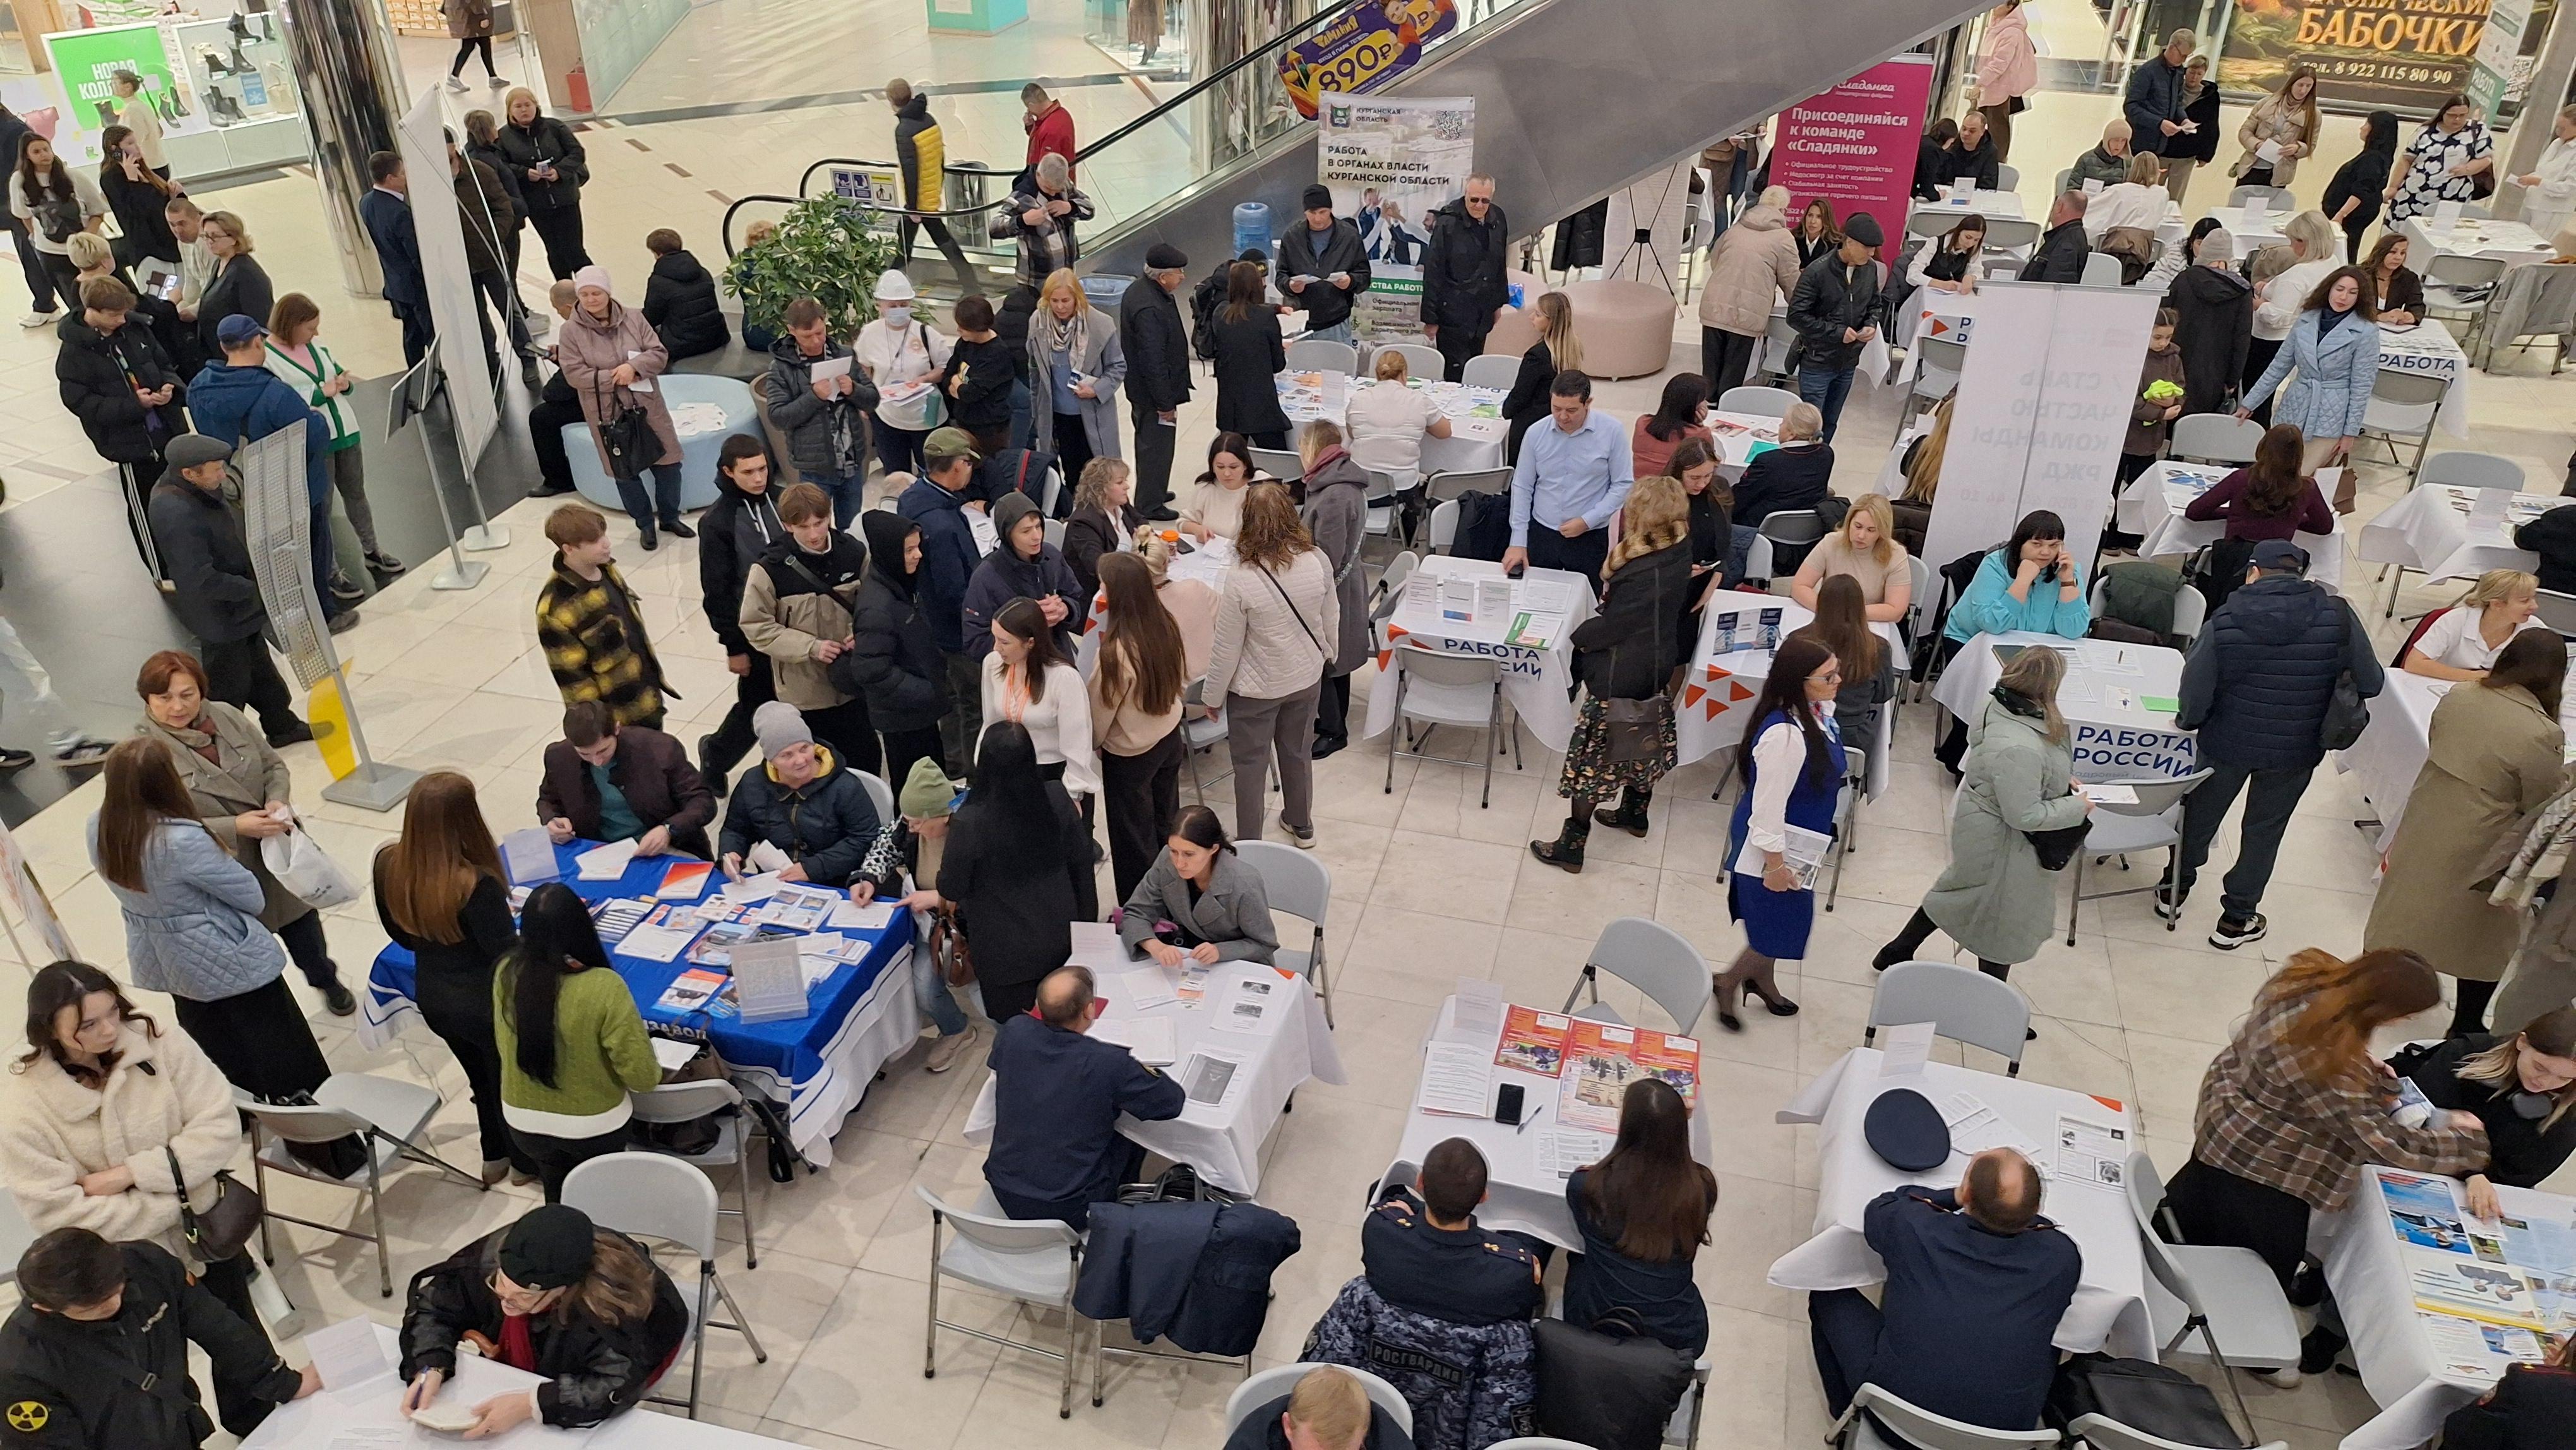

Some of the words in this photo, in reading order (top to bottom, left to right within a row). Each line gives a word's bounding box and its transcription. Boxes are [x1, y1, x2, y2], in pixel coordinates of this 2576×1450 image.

[2295, 8, 2486, 56] БАБОЧКИ
[2334, 61, 2345, 75] 8
[2347, 63, 2376, 78] 922
[2380, 65, 2407, 80] 115
[2409, 68, 2429, 82] 80
[2431, 69, 2452, 84] 90
[1792, 107, 1909, 126] Присоединяйся
[1789, 125, 1798, 136] к
[1802, 126, 1865, 141] команде
[1328, 146, 1368, 156] РАБОТА
[1787, 140, 1878, 155] «Сладянки»
[1337, 159, 1384, 170] ОРГАНАХ
[1387, 162, 1429, 172] ВЛАСТИ
[1327, 172, 1396, 184] КУРГАНСКОЙ
[1400, 176, 1450, 185] ОБЛАСТИ
[2379, 354, 2455, 372] РАБОТА
[1444, 638, 1540, 661] РАБОТА
[1500, 661, 1542, 681] СИИ
[2077, 726, 2193, 757] РАБОТА
[2073, 747, 2194, 777] РОССИИ
[1374, 1345, 1460, 1383] РОСГВАРДИЯ
